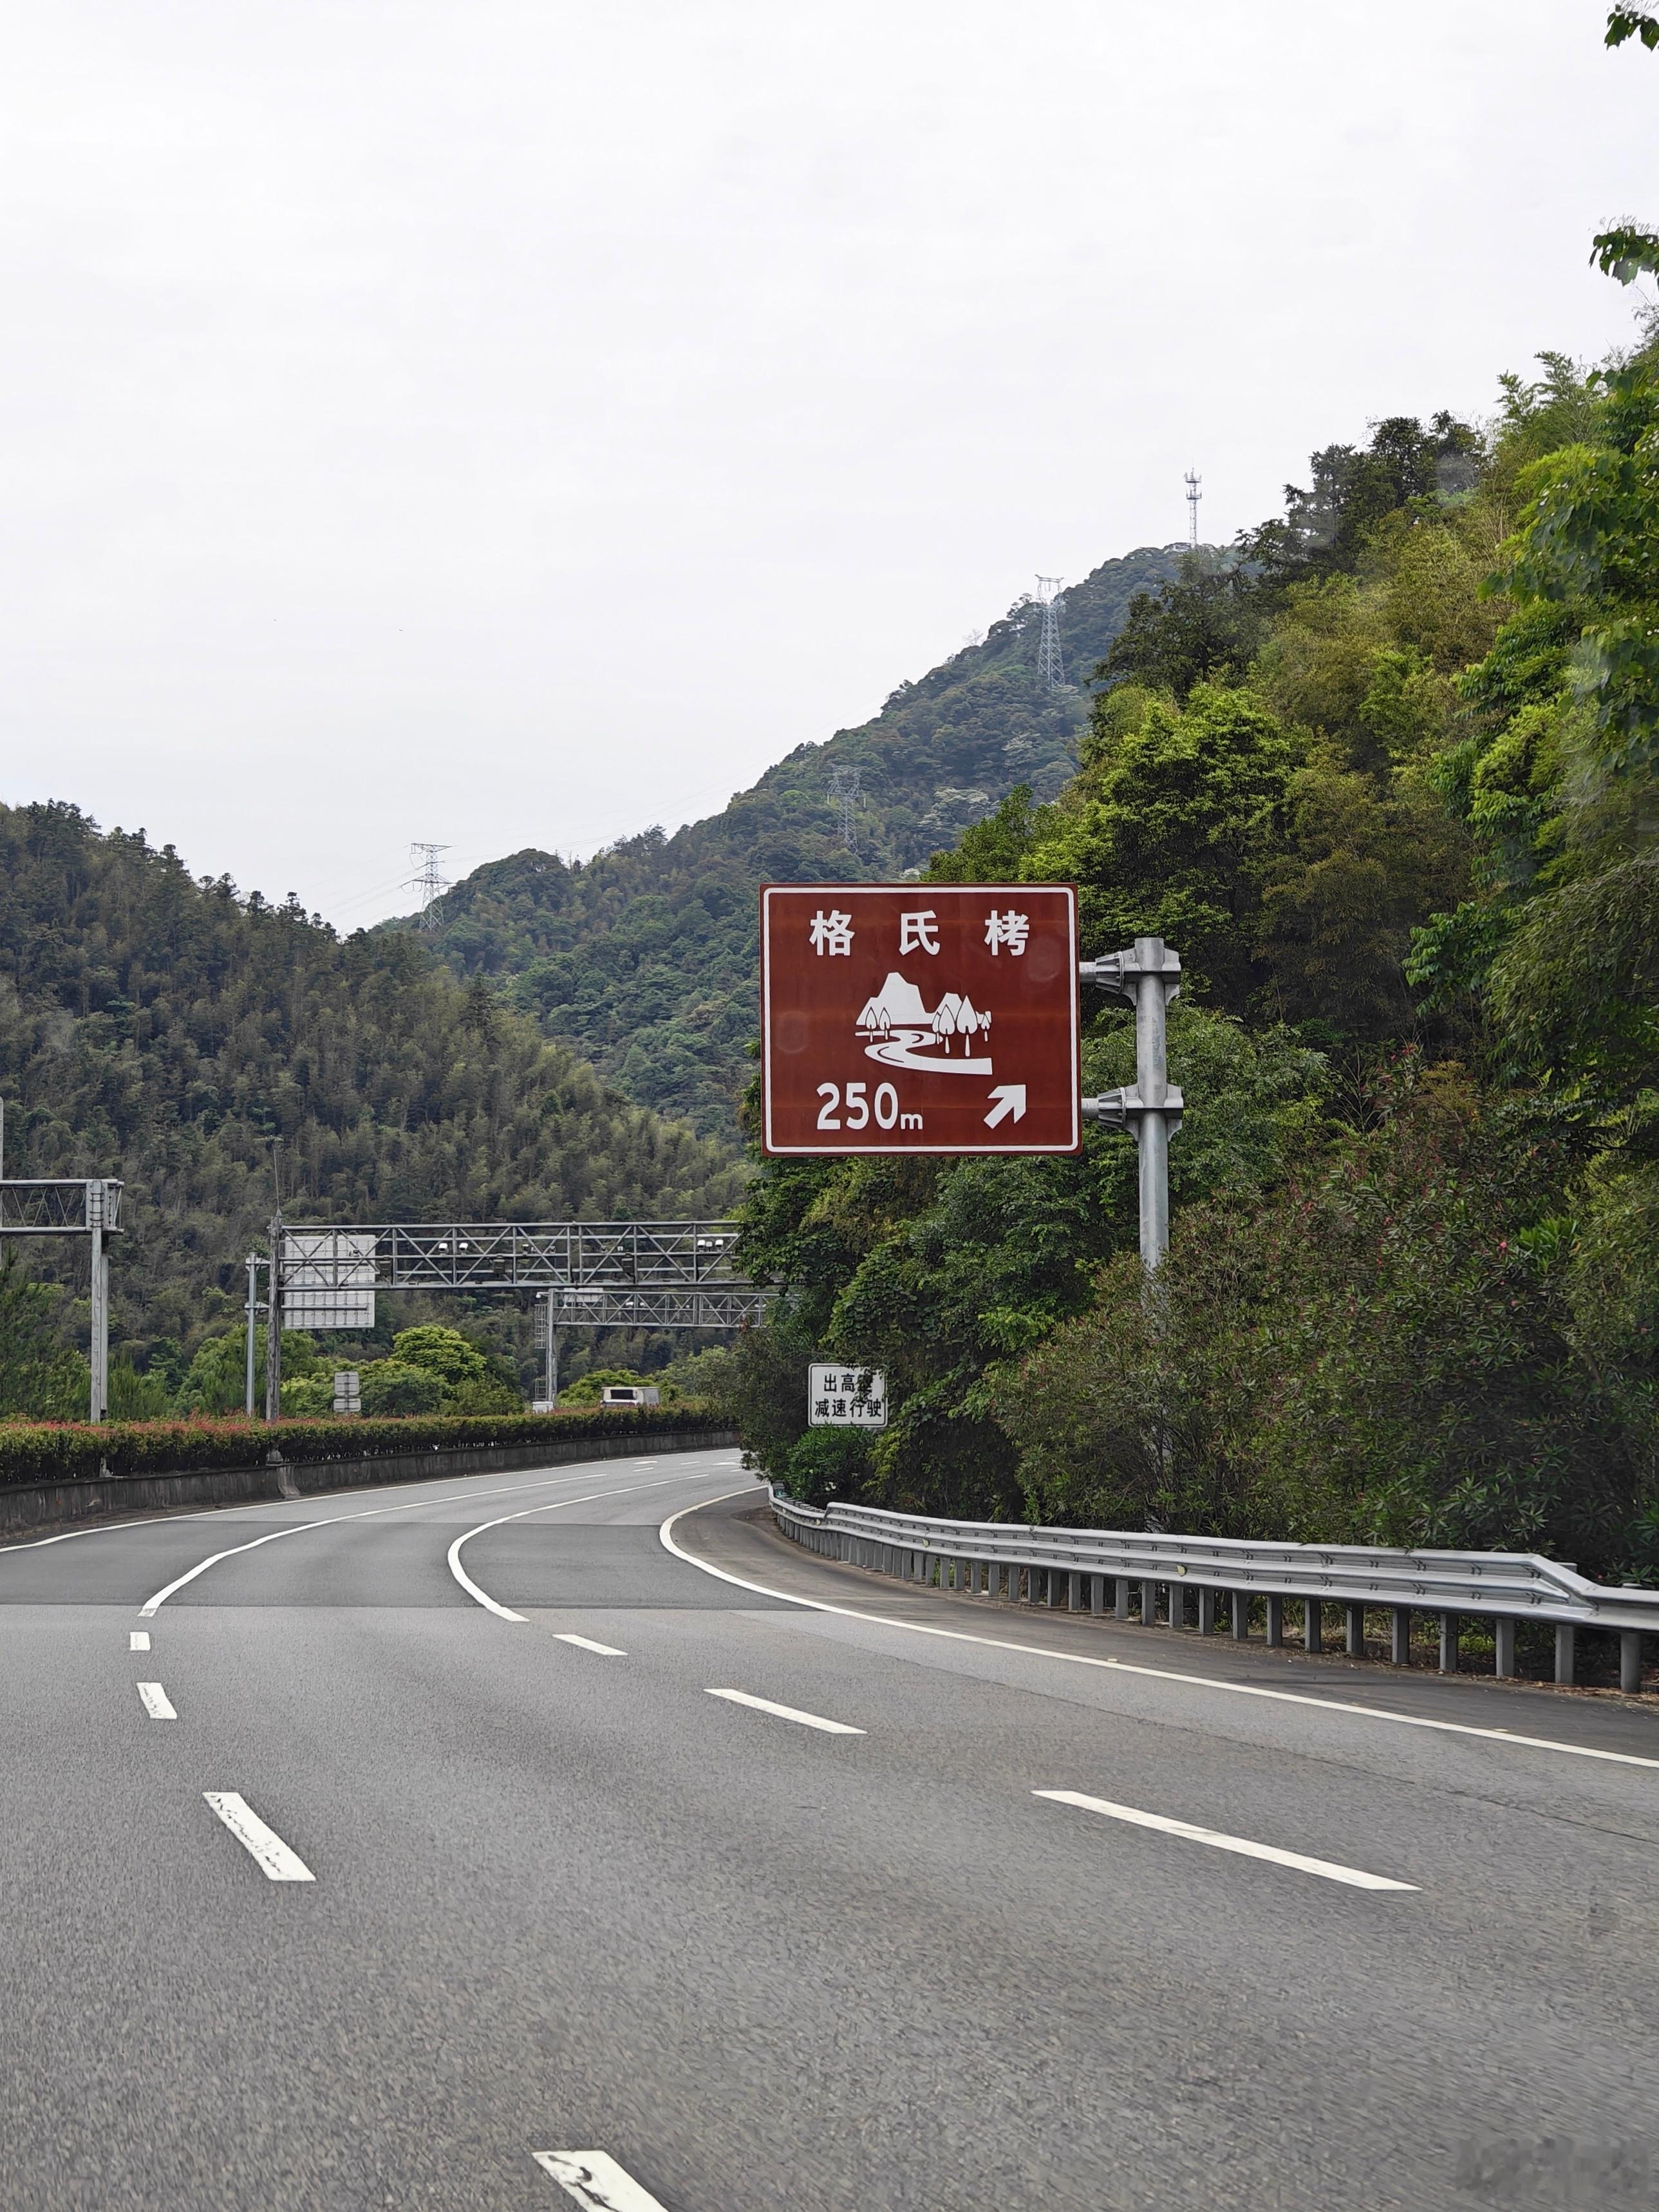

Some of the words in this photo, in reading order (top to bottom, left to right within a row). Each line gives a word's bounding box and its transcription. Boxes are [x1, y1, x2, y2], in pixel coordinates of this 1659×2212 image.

[809, 910, 1029, 956] 格氏栲
[816, 1082, 923, 1130] 250m
[824, 1373, 873, 1393] 出高
[814, 1398, 882, 1418] 减速行驶
